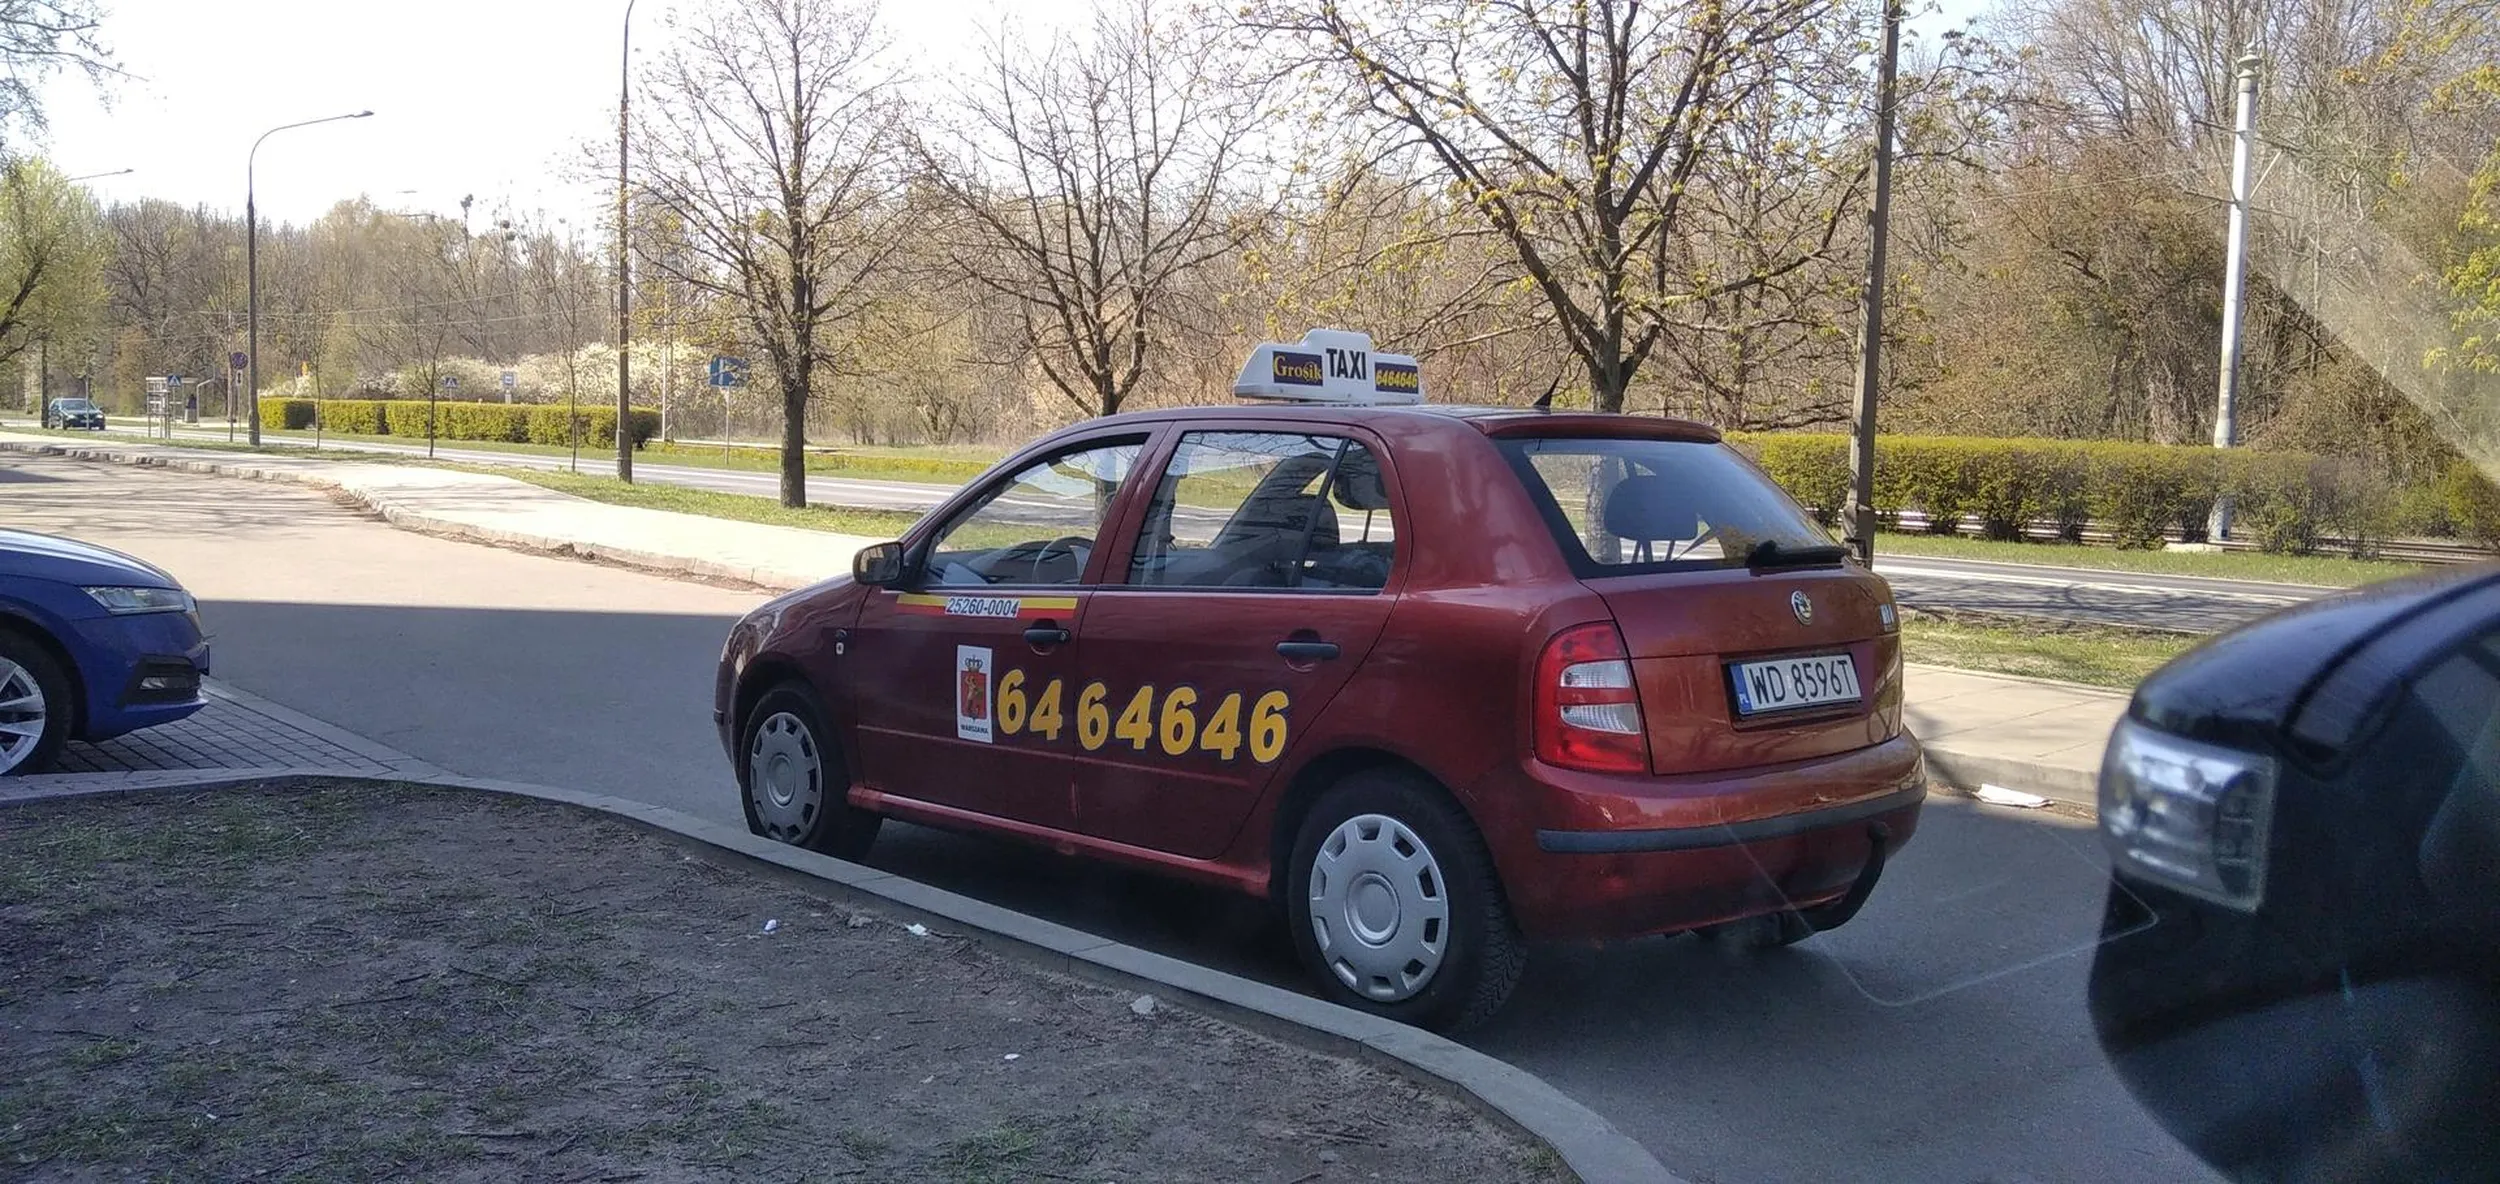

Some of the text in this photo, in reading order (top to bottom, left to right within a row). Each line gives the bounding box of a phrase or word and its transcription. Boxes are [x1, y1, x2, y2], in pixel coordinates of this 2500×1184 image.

[1325, 348, 1366, 380] TAXI
[1375, 369, 1418, 389] 6464646
[946, 597, 1019, 617] 25260-0004
[1749, 660, 1853, 704] WD 8596T
